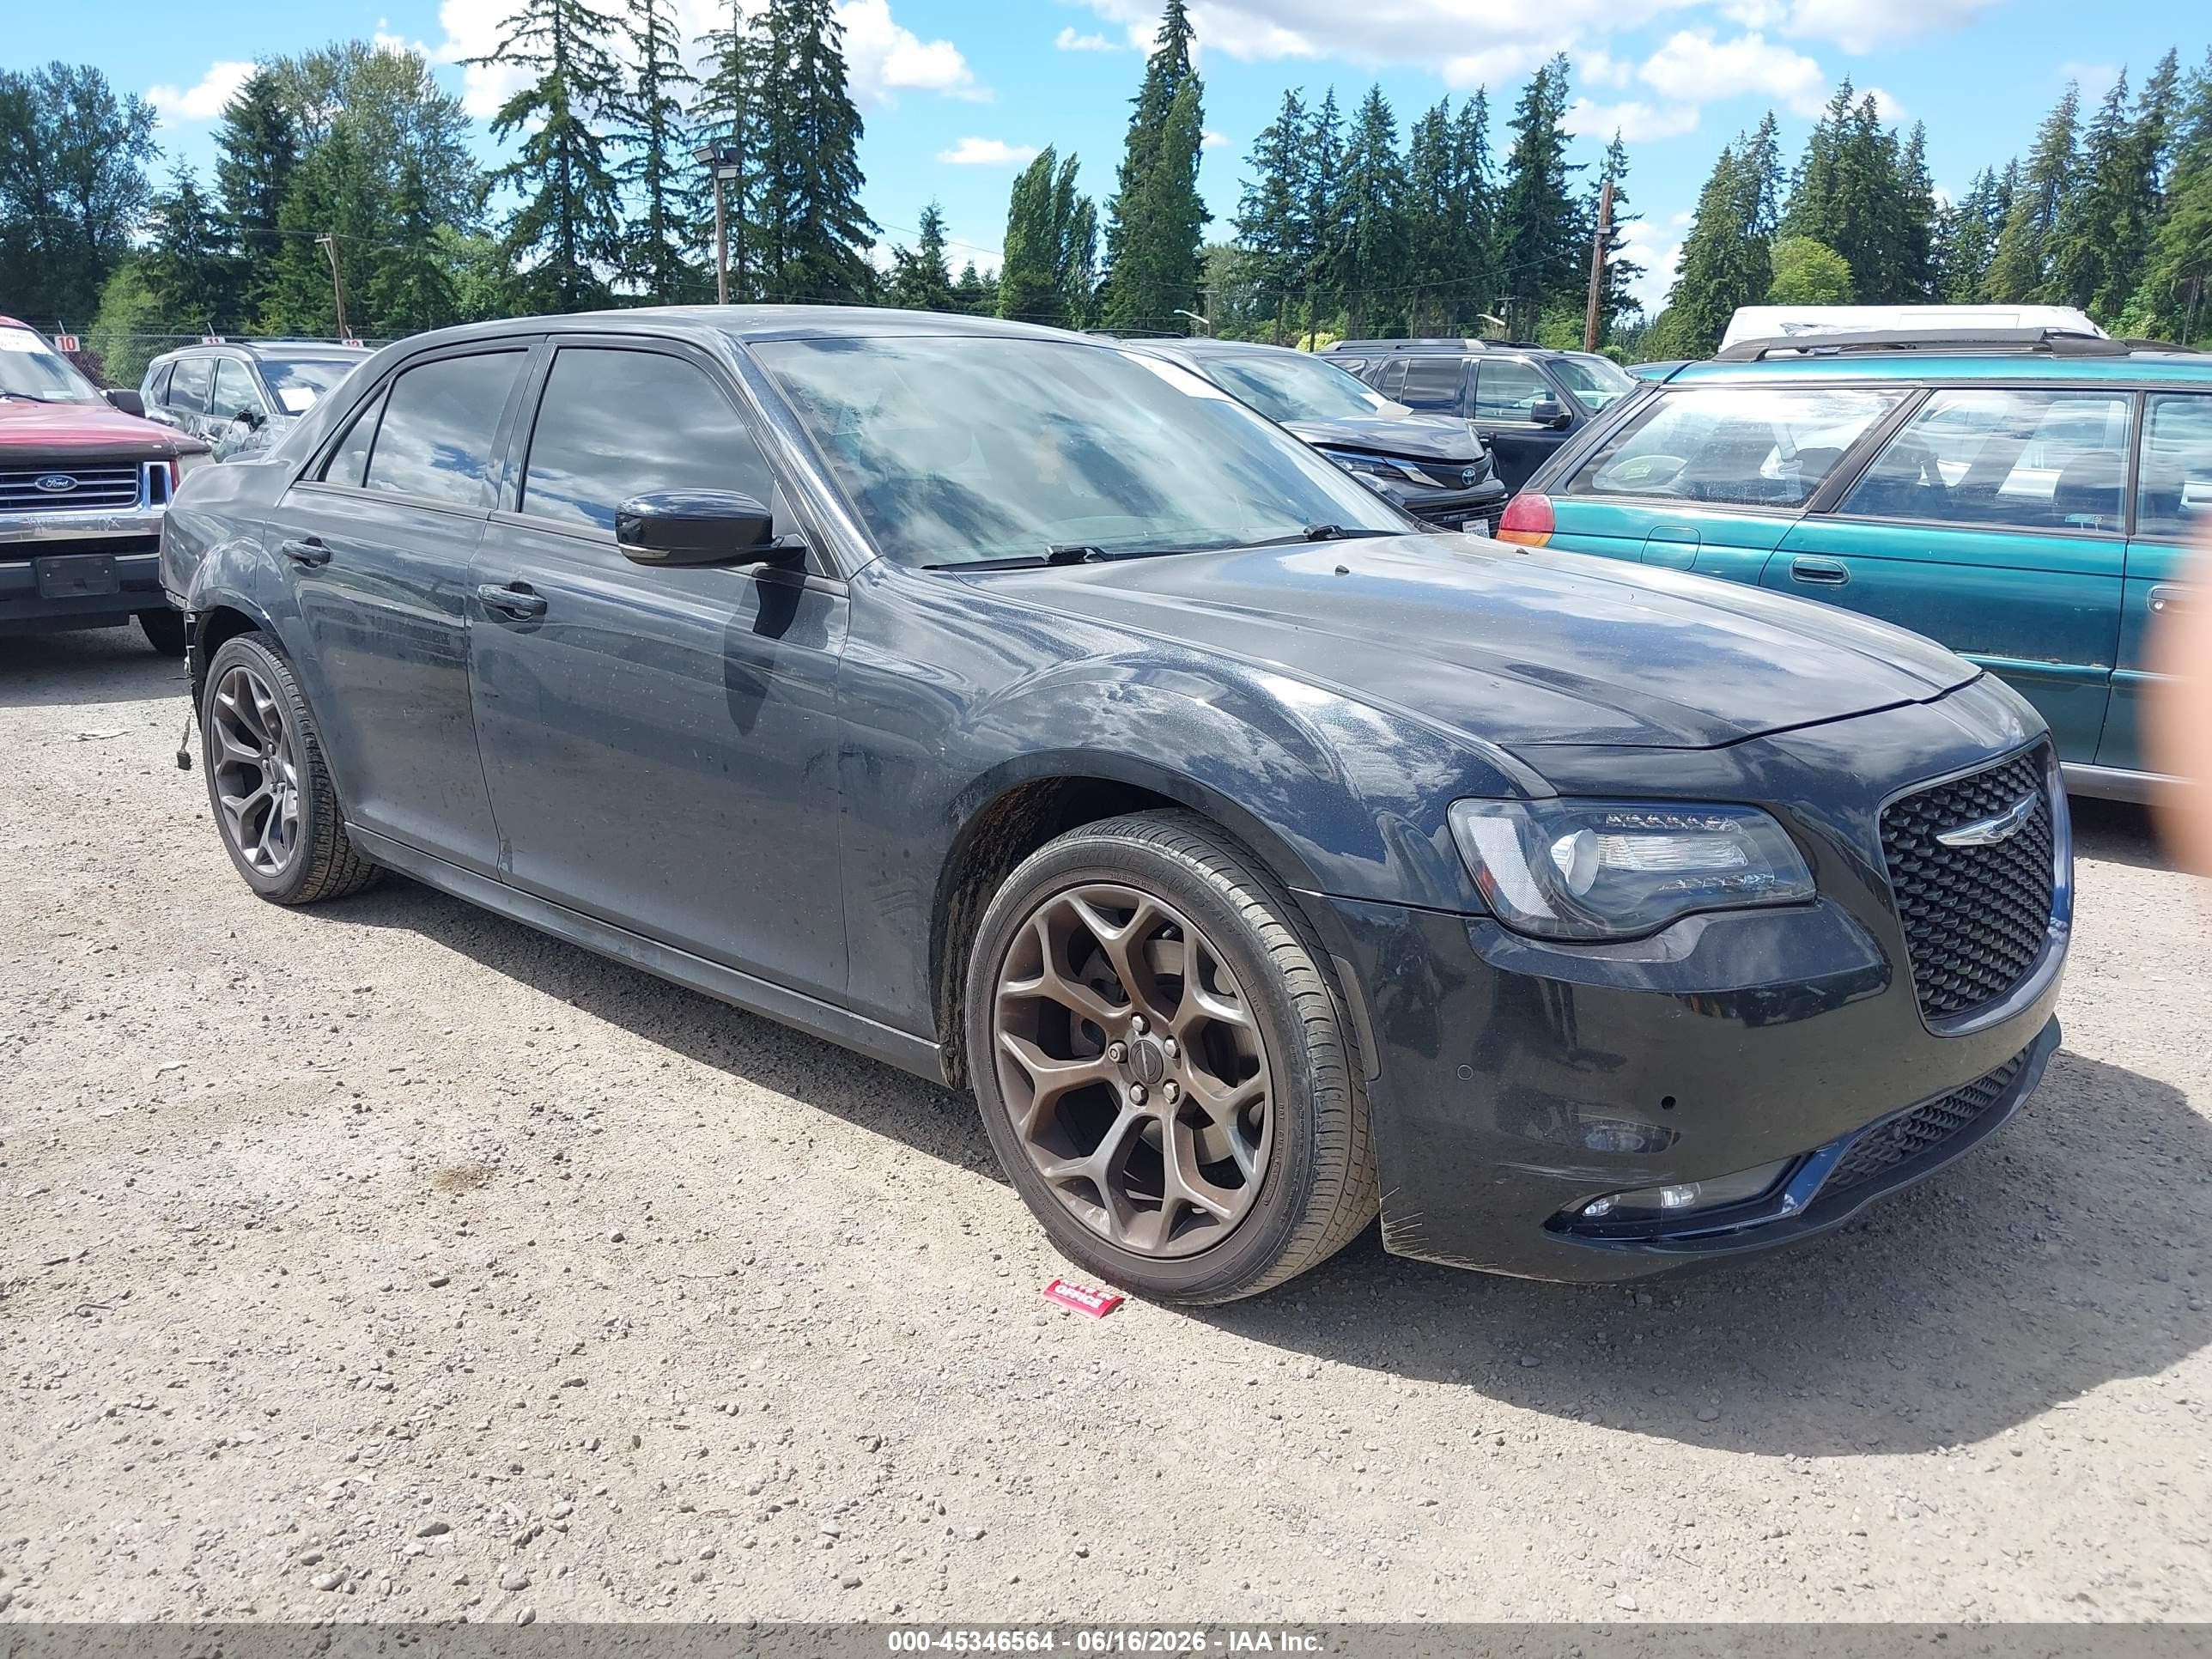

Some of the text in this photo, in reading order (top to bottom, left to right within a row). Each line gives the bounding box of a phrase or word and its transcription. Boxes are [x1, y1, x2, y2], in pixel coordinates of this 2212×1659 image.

[58, 337, 76, 350] 10
[46, 477, 69, 488] Ford
[1054, 1285, 1103, 1309] OFFICE
